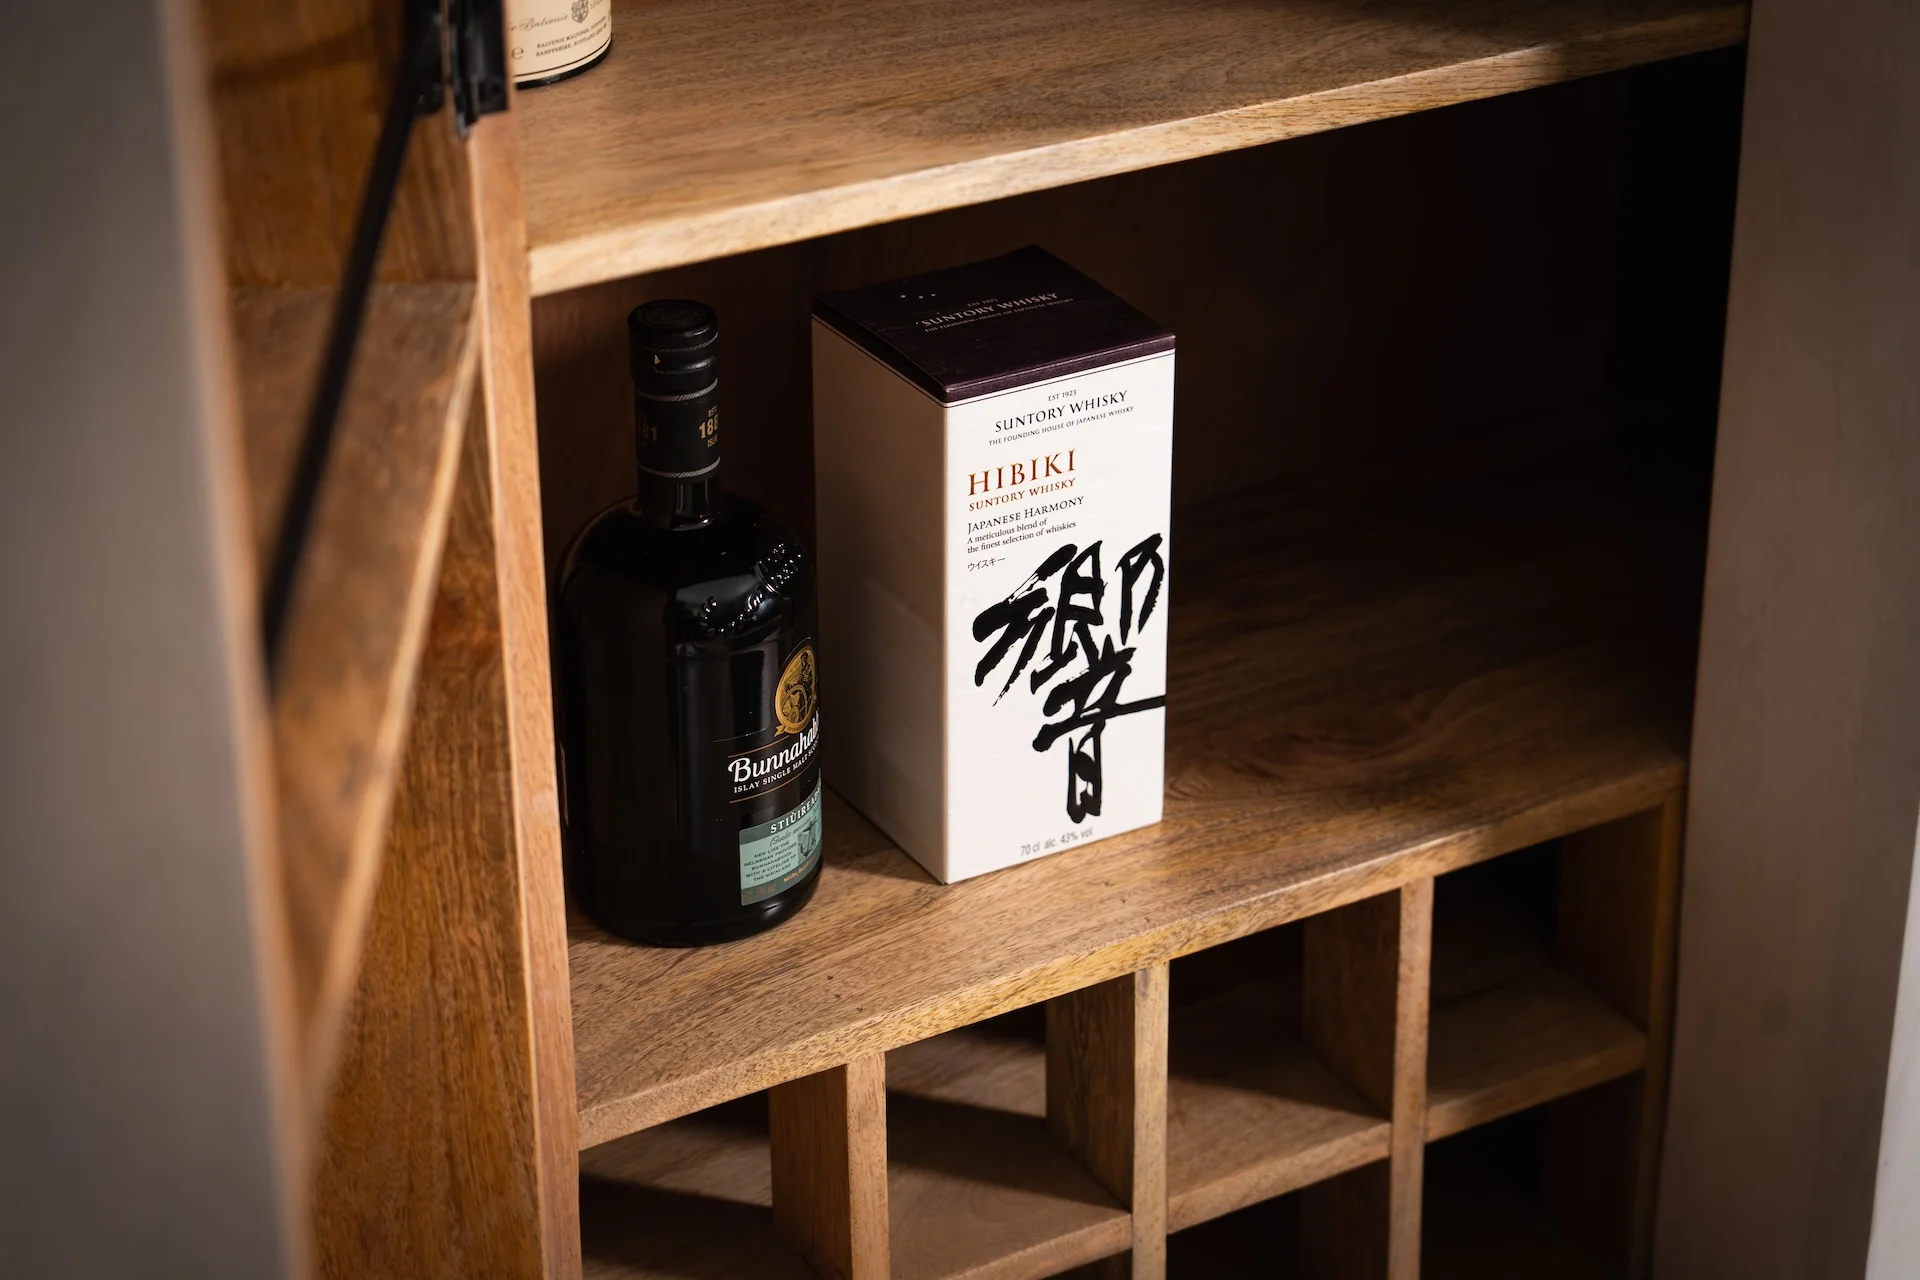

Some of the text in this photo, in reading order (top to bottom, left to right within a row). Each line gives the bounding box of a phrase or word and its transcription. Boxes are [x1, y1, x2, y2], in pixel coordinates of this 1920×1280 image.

[921, 305, 994, 327] SUNTORY
[996, 292, 1058, 309] WHISKY
[995, 390, 1128, 433] SUNTORY WHISKY
[1048, 389, 1077, 402] EST 1923
[699, 414, 719, 439] 188
[988, 406, 1134, 446] THE FOUNDING HOUSE OF JAPANESE WHISKY
[968, 449, 1076, 496] HIBIKI
[969, 477, 1076, 512] SUNTORY WHISKY
[967, 495, 1085, 535] JAPANESE HARMONY
[967, 518, 1048, 545] A meticulous blend of
[967, 521, 1077, 554] the finest selection of whiskies
[967, 556, 1006, 572] ウイスキー
[734, 781, 760, 793] ISLAY
[763, 768, 791, 786] SINGLE
[793, 754, 808, 771] MALT
